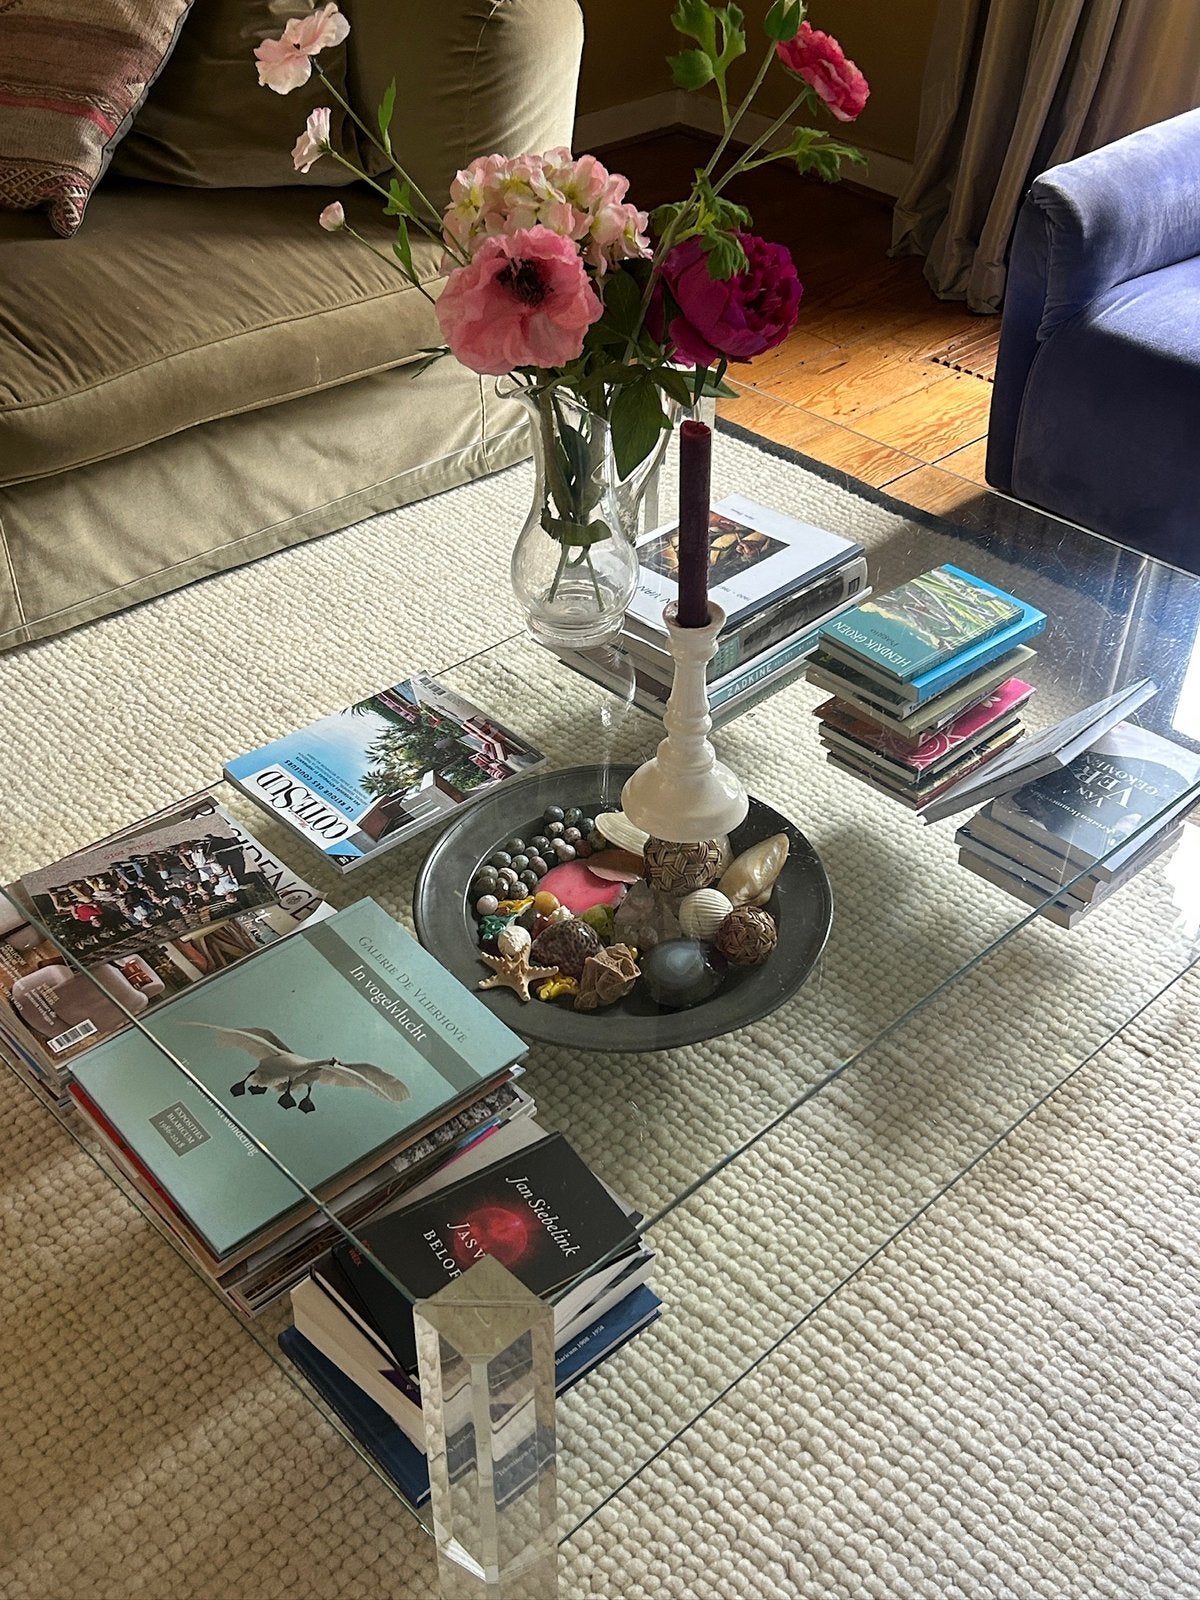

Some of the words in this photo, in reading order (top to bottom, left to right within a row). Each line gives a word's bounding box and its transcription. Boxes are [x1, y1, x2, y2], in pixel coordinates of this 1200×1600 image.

[832, 621, 867, 643] GROEN
[865, 639, 911, 667] HENDRIK
[727, 663, 773, 697] ZADKINE
[283, 759, 313, 781] COULEURS
[312, 780, 325, 791] DES
[323, 789, 347, 809] RETOUR
[1076, 786, 1104, 809] VAN
[181, 800, 323, 921] RDENCE
[349, 964, 366, 982] In
[364, 979, 428, 1043] vogelvlucht
[358, 936, 398, 975] GALERIE
[396, 972, 414, 991] DE
[414, 988, 468, 1044] VLIERHOVE
[166, 1112, 196, 1145] BLARICUM
[173, 1106, 205, 1140] EXPOSITIES
[505, 1175, 534, 1200] Jan
[528, 1197, 581, 1258] Siebelink
[446, 1221, 478, 1250] JAS
[422, 1228, 464, 1280] BELOF
